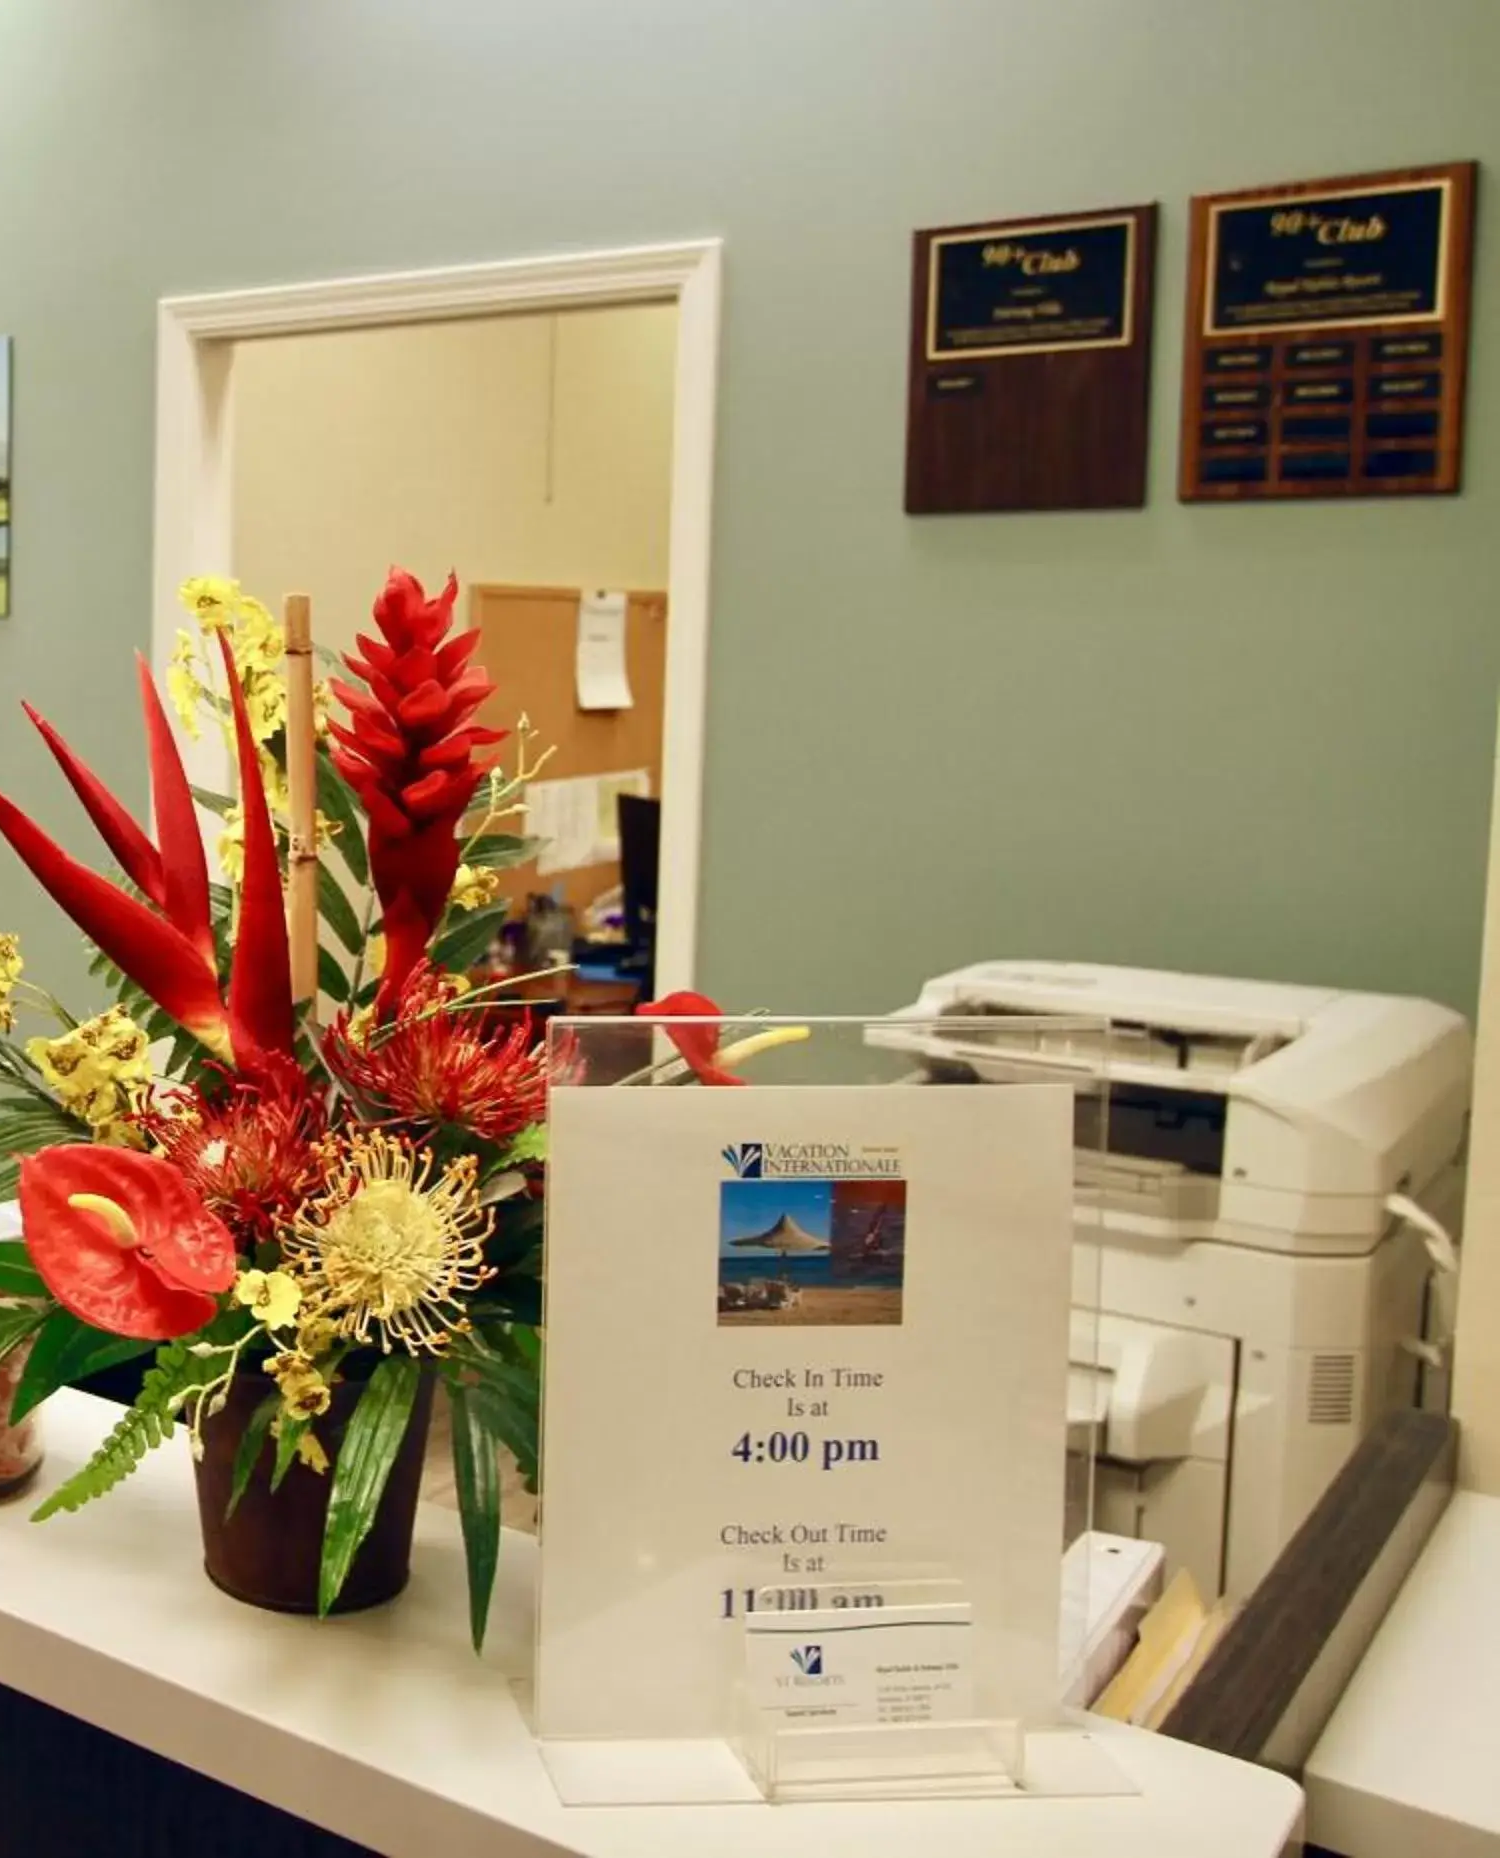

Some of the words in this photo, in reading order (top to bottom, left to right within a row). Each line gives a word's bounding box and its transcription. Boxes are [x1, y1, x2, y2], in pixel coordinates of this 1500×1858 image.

[1317, 214, 1386, 245] Club
[1022, 248, 1081, 275] Club
[764, 1143, 850, 1158] VACATION
[763, 1158, 901, 1174] INTERNATIONALE
[733, 1369, 797, 1388] Check
[804, 1369, 824, 1387] In
[831, 1368, 883, 1387] Time
[787, 1397, 805, 1416] Is
[810, 1400, 828, 1416] at
[732, 1431, 809, 1463] 4:00
[822, 1438, 880, 1470] pm
[720, 1525, 784, 1544] Check
[790, 1525, 827, 1543] Out
[835, 1523, 887, 1543] Time
[783, 1553, 801, 1573] Is
[806, 1555, 824, 1573] at
